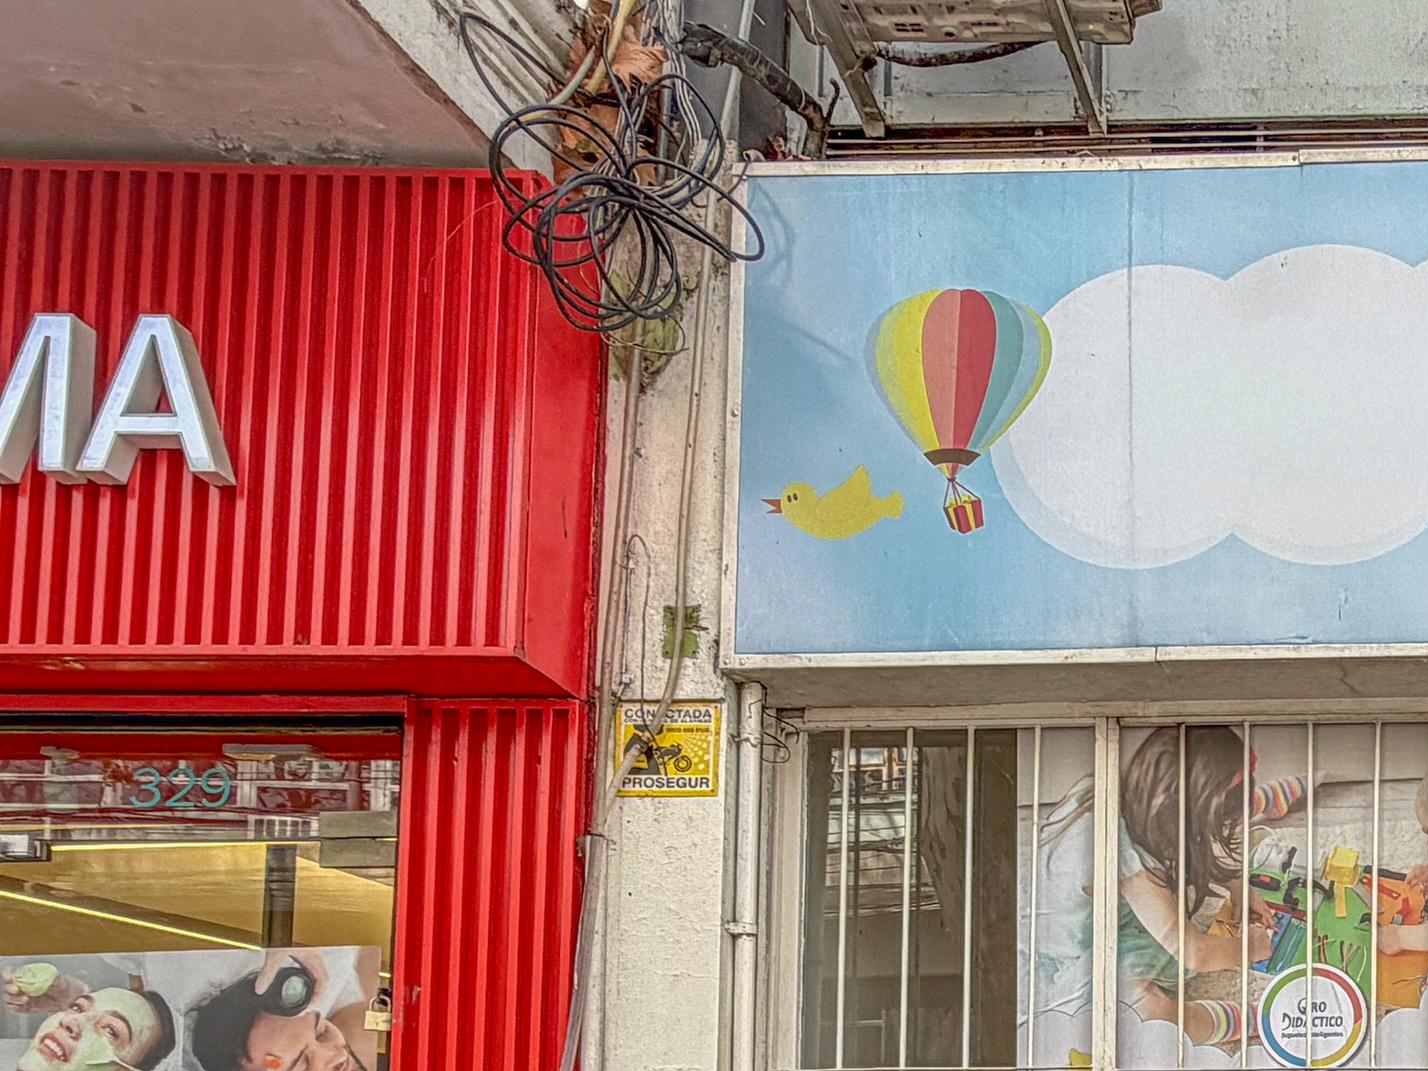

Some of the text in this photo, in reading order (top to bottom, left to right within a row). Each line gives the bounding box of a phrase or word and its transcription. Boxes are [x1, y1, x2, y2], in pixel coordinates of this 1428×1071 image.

[624, 708, 712, 719] CONCTADA
[128, 766, 233, 809] 329
[622, 777, 710, 788] PROSEGUR
